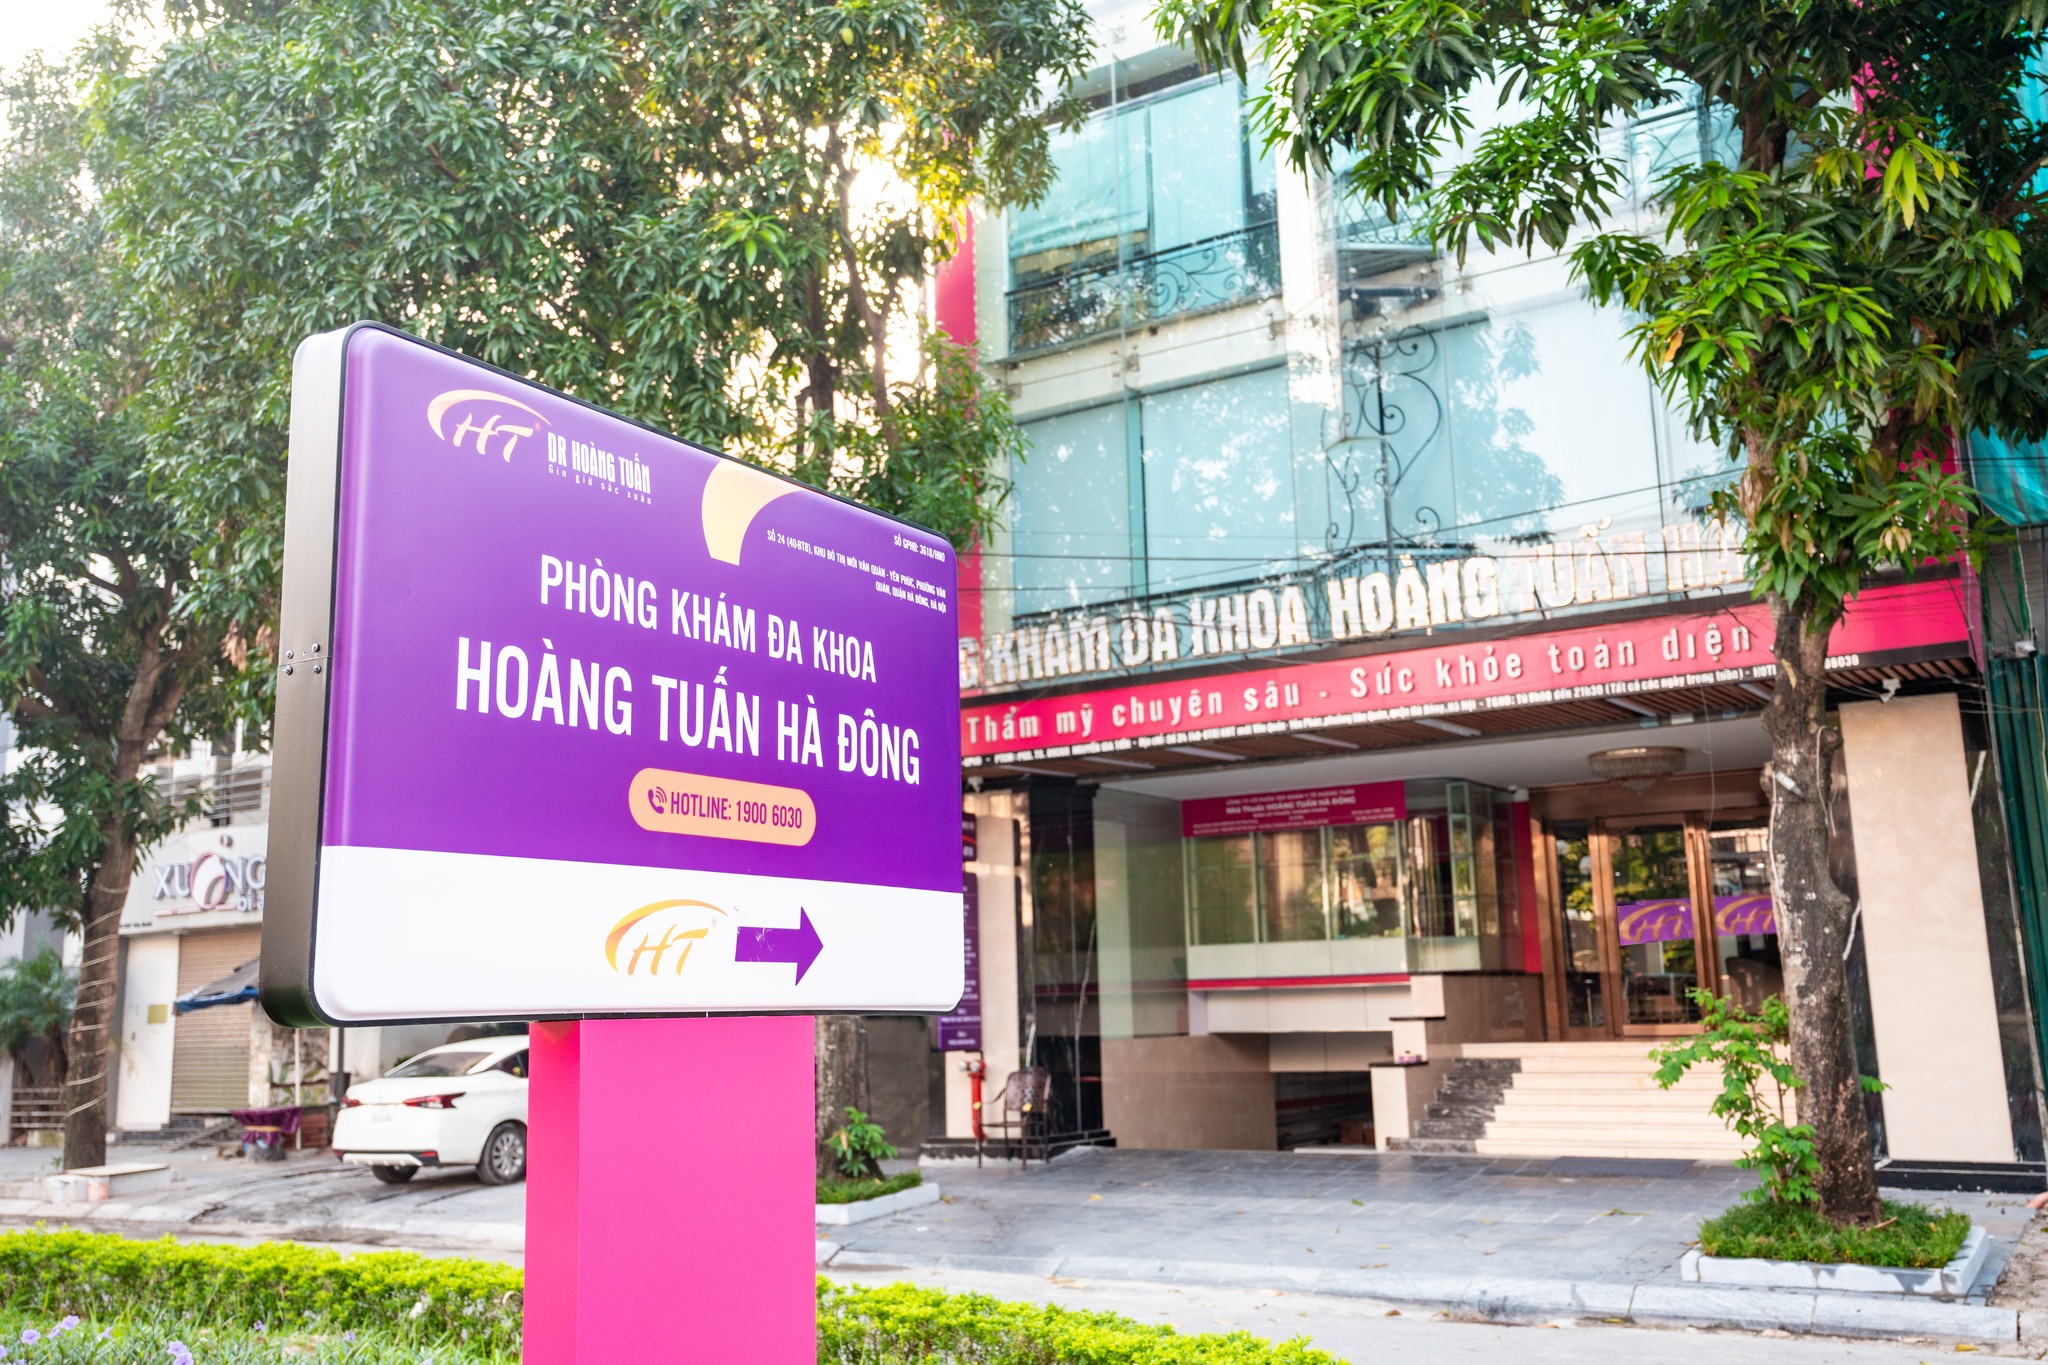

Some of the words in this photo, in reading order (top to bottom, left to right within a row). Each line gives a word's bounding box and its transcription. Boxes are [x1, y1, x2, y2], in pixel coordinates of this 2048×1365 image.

[548, 432, 567, 467] DR
[572, 441, 615, 483] HOÀNG
[618, 452, 651, 494] TUẤN
[767, 528, 776, 542] SỐ
[777, 533, 785, 545] 24
[814, 545, 826, 558] KHU
[837, 553, 846, 566] THỊ
[871, 564, 886, 578] QUÁN
[889, 569, 900, 583] YÊN
[991, 611, 1111, 684] KHÁM
[1190, 586, 1311, 656] KHOA
[1327, 554, 1499, 639] HOÀNG
[1507, 516, 1649, 612] TUẤN
[541, 554, 658, 630] PHÒNG
[672, 588, 756, 653] KHÁM
[767, 613, 804, 665] ĐA
[813, 626, 877, 683] KHOA
[455, 636, 633, 737] HOÀNG
[652, 665, 761, 757] TUẤN
[777, 694, 824, 768] HÀ
[837, 708, 920, 785] ĐÔNG
[966, 705, 1039, 745] Thẩm
[1056, 703, 1094, 737] mỹ
[1112, 689, 1222, 728] chuyên
[1243, 680, 1300, 711] sâu
[1350, 661, 1414, 698] Sức
[1435, 645, 1522, 687] khỏe
[1547, 636, 1636, 674] toàn
[670, 791, 733, 822] HOTLINE:
[735, 800, 767, 826] 1900
[772, 804, 802, 830] 6030
